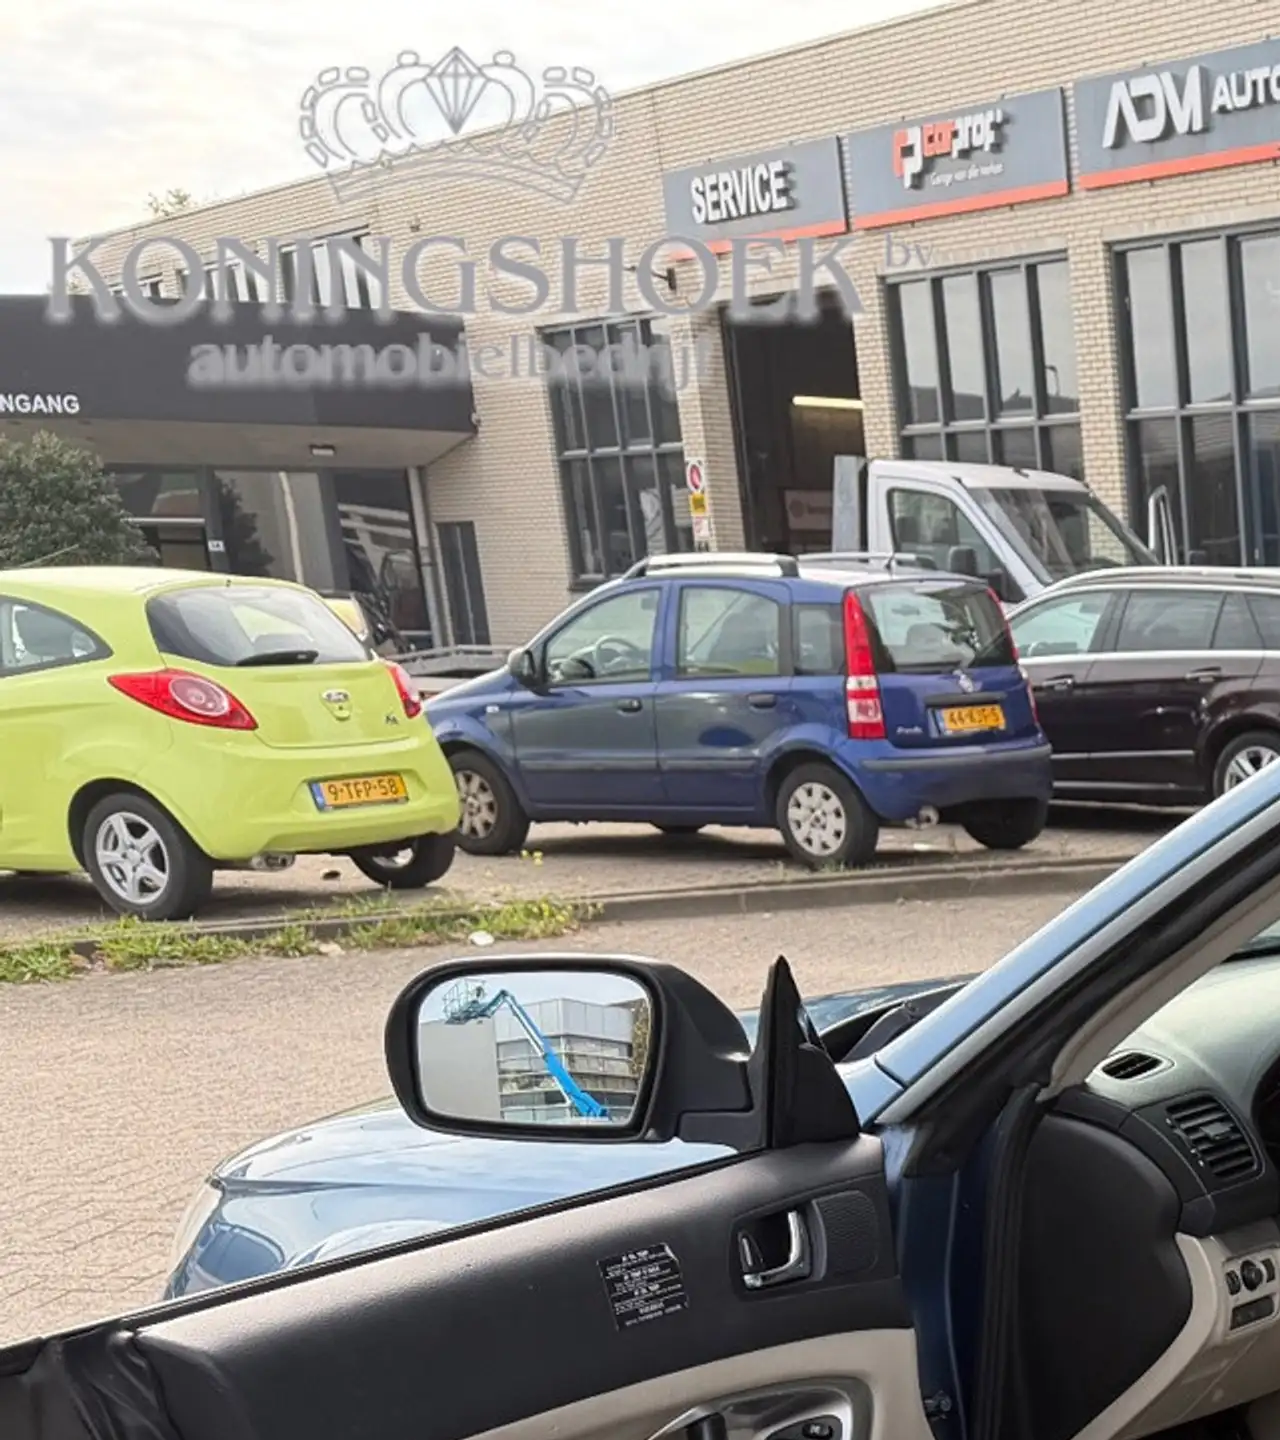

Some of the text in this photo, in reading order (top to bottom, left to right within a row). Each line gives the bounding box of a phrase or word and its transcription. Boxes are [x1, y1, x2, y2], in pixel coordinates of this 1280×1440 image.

[1102, 65, 1203, 149] ADM
[690, 160, 787, 223] SERVICE
[328, 778, 399, 801] 9-TFP-58
